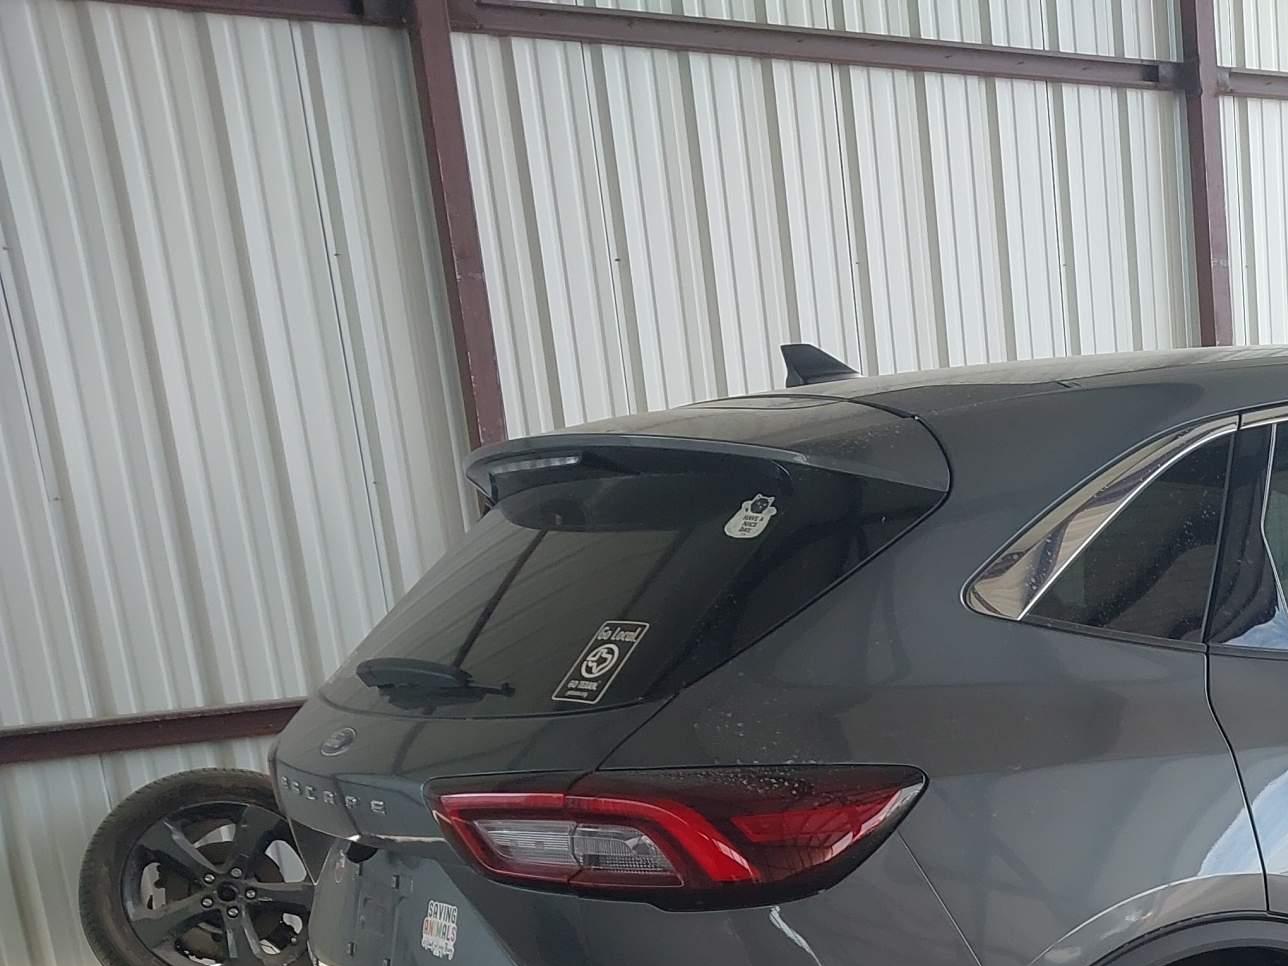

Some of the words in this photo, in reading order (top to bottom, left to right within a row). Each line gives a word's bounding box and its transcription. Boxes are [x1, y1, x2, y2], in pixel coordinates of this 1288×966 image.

[597, 626, 612, 641] Go
[428, 900, 457, 924] SAVING
[423, 917, 457, 943] ANIMALS
